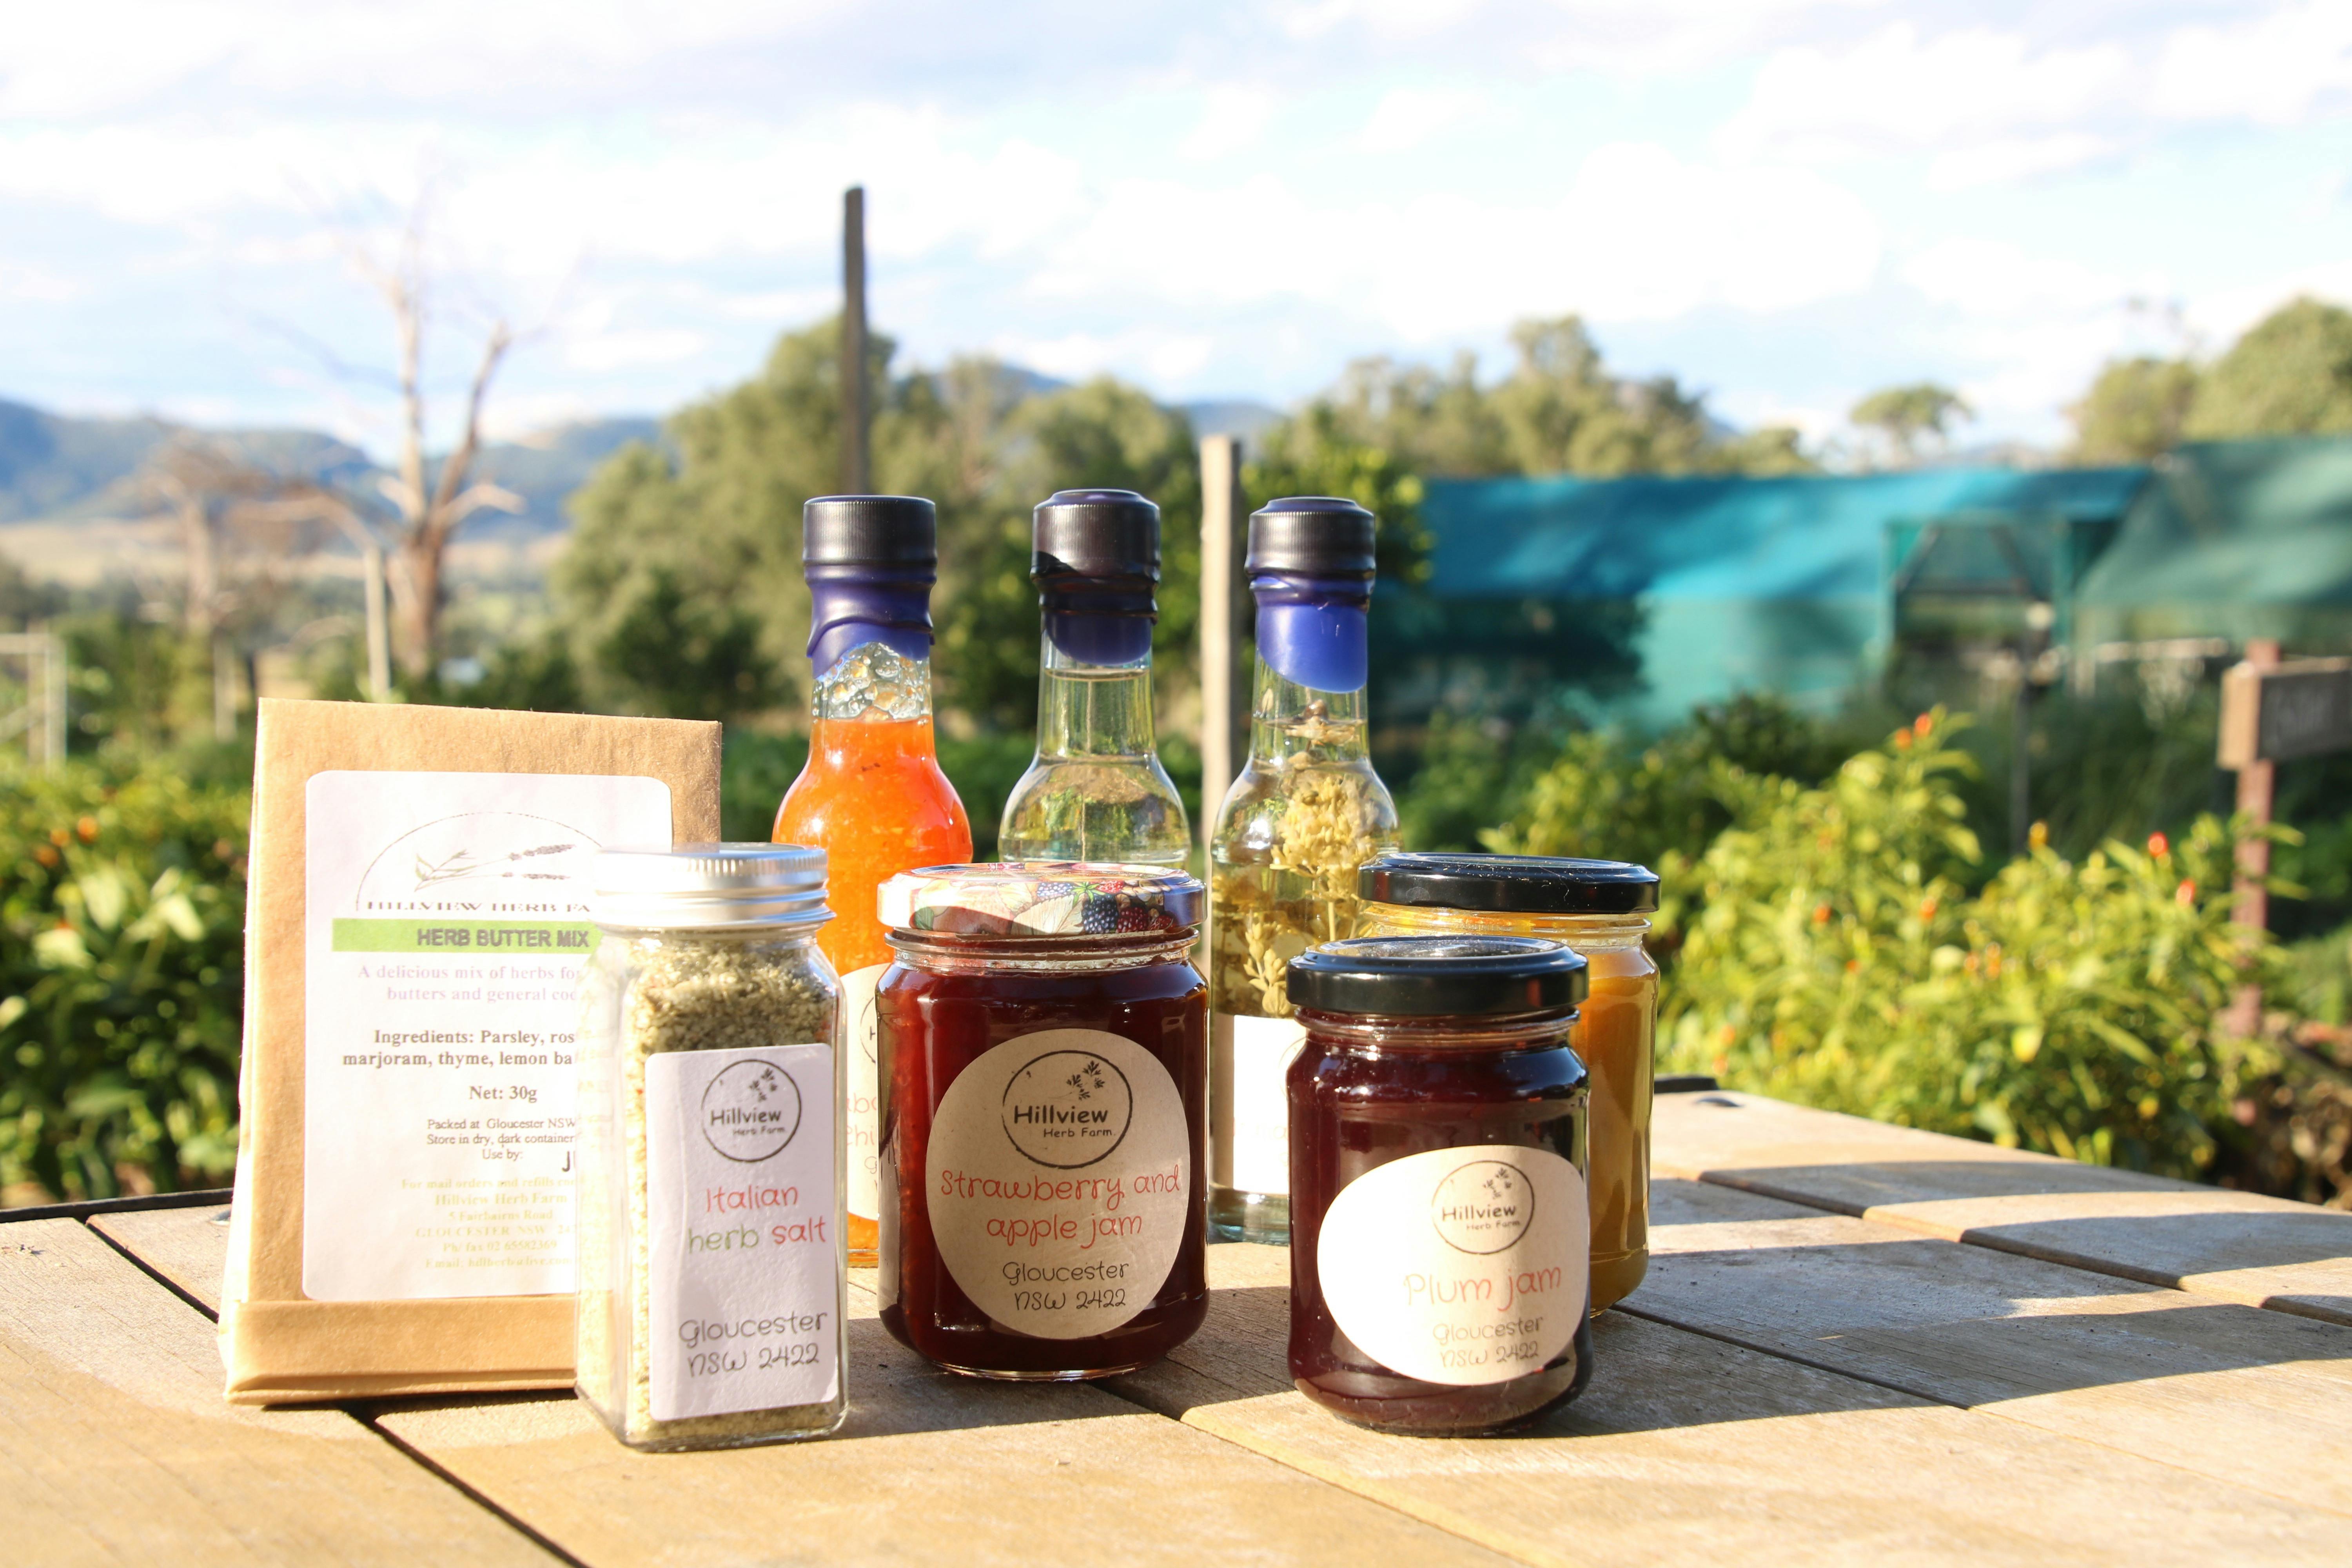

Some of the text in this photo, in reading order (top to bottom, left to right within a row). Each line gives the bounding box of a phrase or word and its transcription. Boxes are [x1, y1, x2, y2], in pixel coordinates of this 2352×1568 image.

[367, 901, 590, 913] HILLVIEW HERB FA
[417, 928, 590, 948] HERB BUTTER MIX
[358, 966, 370, 978] A
[377, 965, 448, 979] delicious
[455, 966, 484, 979] mix
[489, 967, 506, 979] of
[511, 967, 555, 980] herbs
[387, 987, 446, 1000] butters
[452, 988, 481, 1000] and
[487, 988, 546, 1004] general
[374, 1029, 575, 1047] Ingredients: Parsley, ros
[343, 1051, 572, 1069] marjoram, thyme, lemon ba
[469, 1085, 538, 1103] Net: 30g
[710, 1107, 782, 1126] Hillview
[1013, 1105, 1109, 1124] Hillview
[427, 1118, 576, 1130] Packed at Gloucester NSW
[732, 1127, 757, 1136] Herb
[1043, 1127, 1075, 1138] Herb
[427, 1134, 456, 1145] Store
[459, 1133, 470, 1144] in
[472, 1133, 495, 1146] dry,
[497, 1133, 521, 1144] dark
[482, 1149, 524, 1162] Use by:
[402, 1179, 422, 1189] For
[426, 1178, 452, 1189] mail
[456, 1178, 493, 1189] orders
[497, 1178, 518, 1188] and
[522, 1176, 554, 1187] refills
[941, 1163, 1180, 1211] Strawberry and
[435, 1192, 567, 1206] Hillview Herb Farm
[705, 1184, 799, 1214] Italian
[524, 1210, 553, 1220] Road
[1442, 1205, 1517, 1221] Hillview
[415, 1226, 510, 1238] GLOUCESTER
[517, 1225, 545, 1234] NSW
[688, 1216, 827, 1253] herb salt
[986, 1213, 1143, 1249] apple jam
[1466, 1221, 1491, 1230] Herb
[466, 1242, 483, 1252] fax
[487, 1241, 500, 1252] 02
[1002, 1261, 1129, 1286] Gloucester
[1403, 1266, 1561, 1312] Plum jam
[1076, 1288, 1127, 1309] 2422
[679, 1311, 828, 1348] Gloucester
[1432, 1316, 1544, 1346] Gloucester
[759, 1343, 820, 1368] 2422
[1496, 1341, 1539, 1364] 2422
